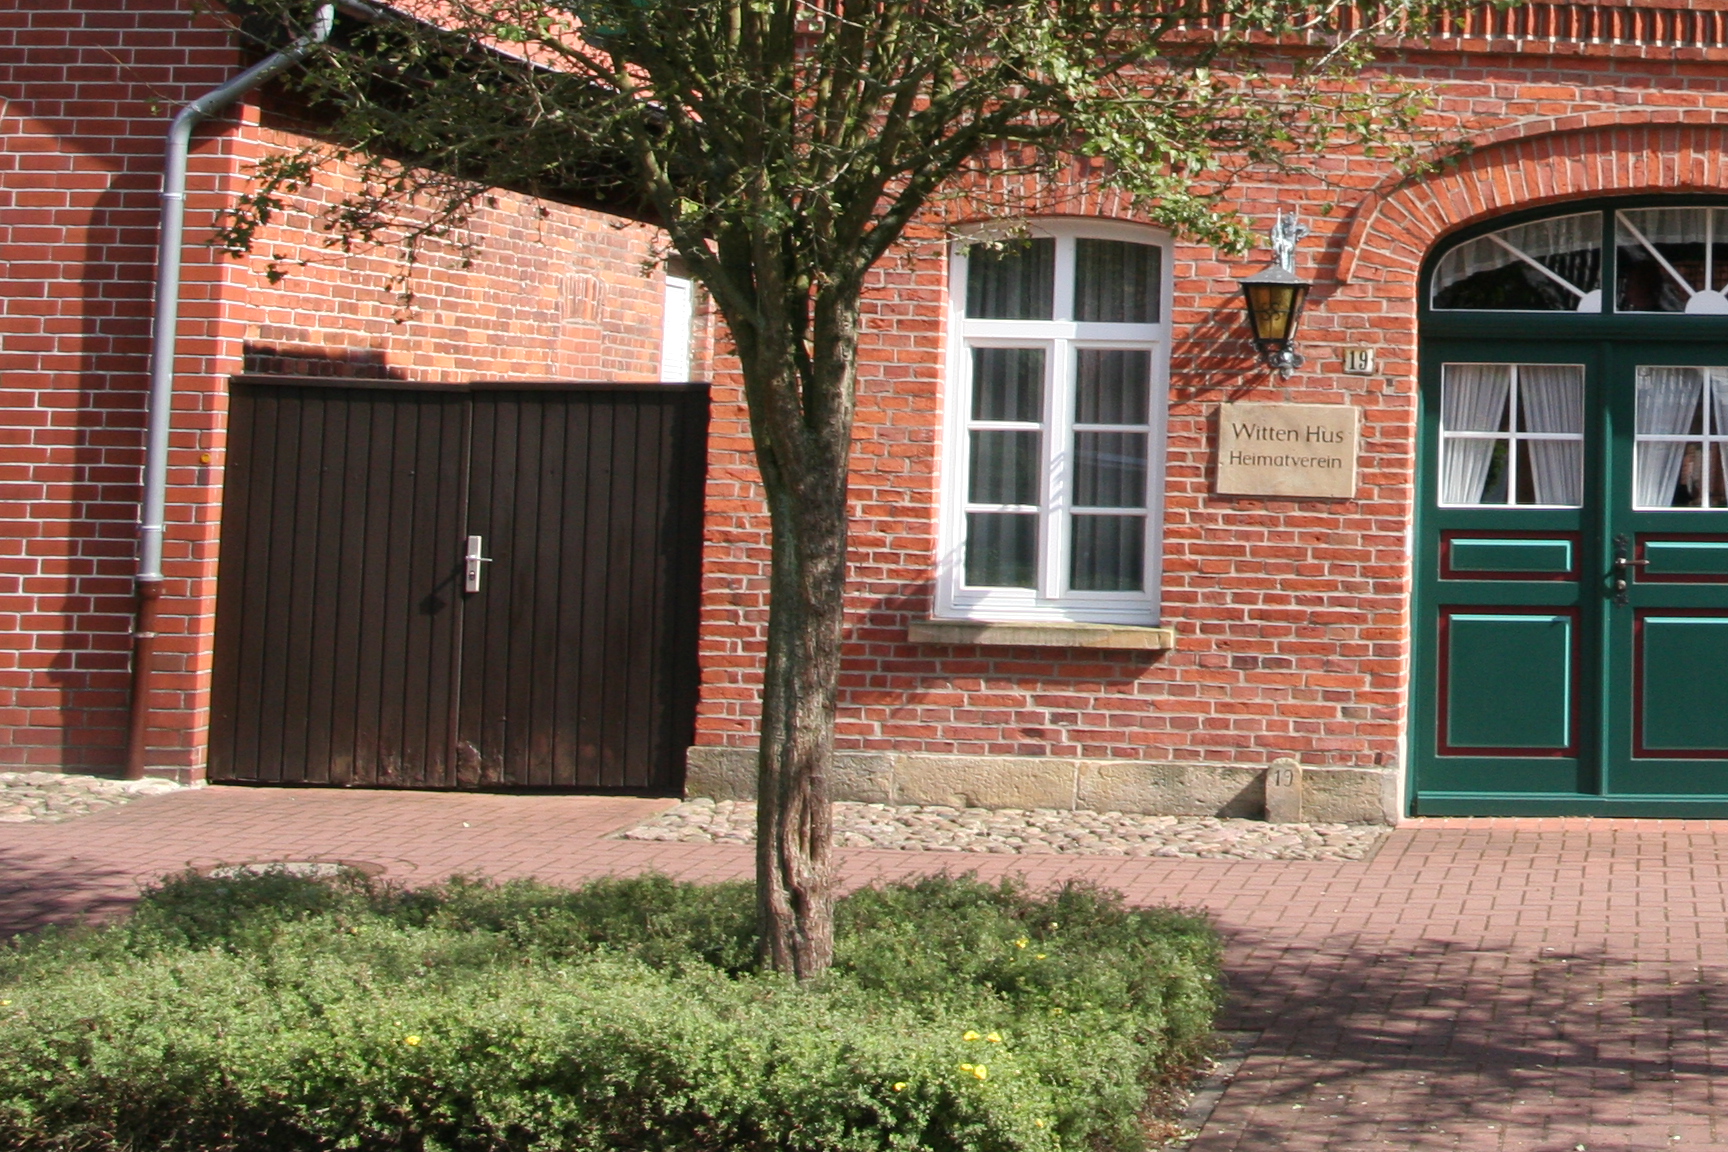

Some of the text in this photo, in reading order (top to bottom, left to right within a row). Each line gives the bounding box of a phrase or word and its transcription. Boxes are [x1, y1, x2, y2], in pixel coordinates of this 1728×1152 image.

[1349, 351, 1368, 371] 19
[1232, 422, 1344, 444] Witten Hus
[1229, 450, 1342, 469] Heimatverein
[1274, 769, 1293, 787] 19
